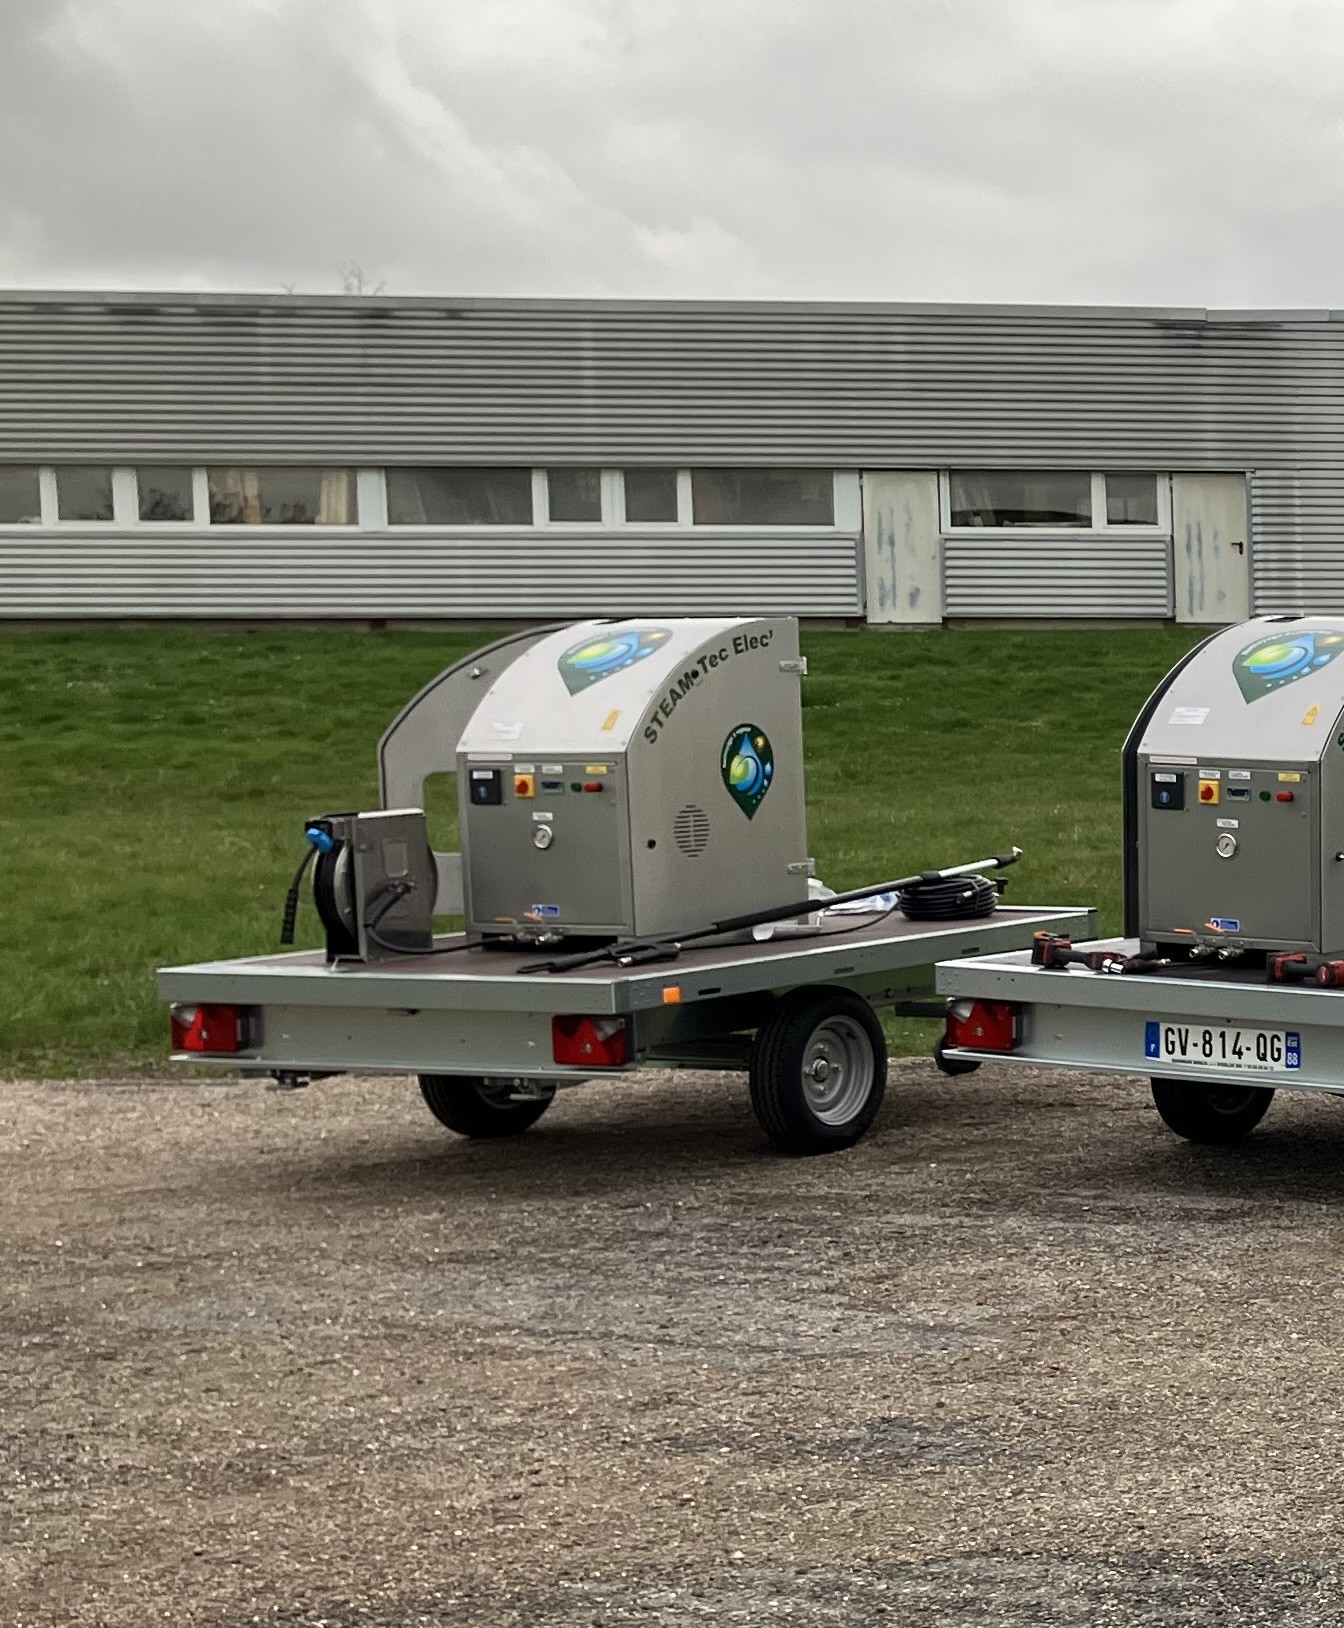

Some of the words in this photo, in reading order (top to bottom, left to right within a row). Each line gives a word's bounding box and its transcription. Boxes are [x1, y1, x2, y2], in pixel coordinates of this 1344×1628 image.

[643, 671, 695, 745] STEAM
[697, 647, 729, 674] Tec
[732, 629, 774, 655] Elec'
[1164, 1026, 1282, 1063] GV-814-QG
[1286, 1052, 1299, 1066] 88
